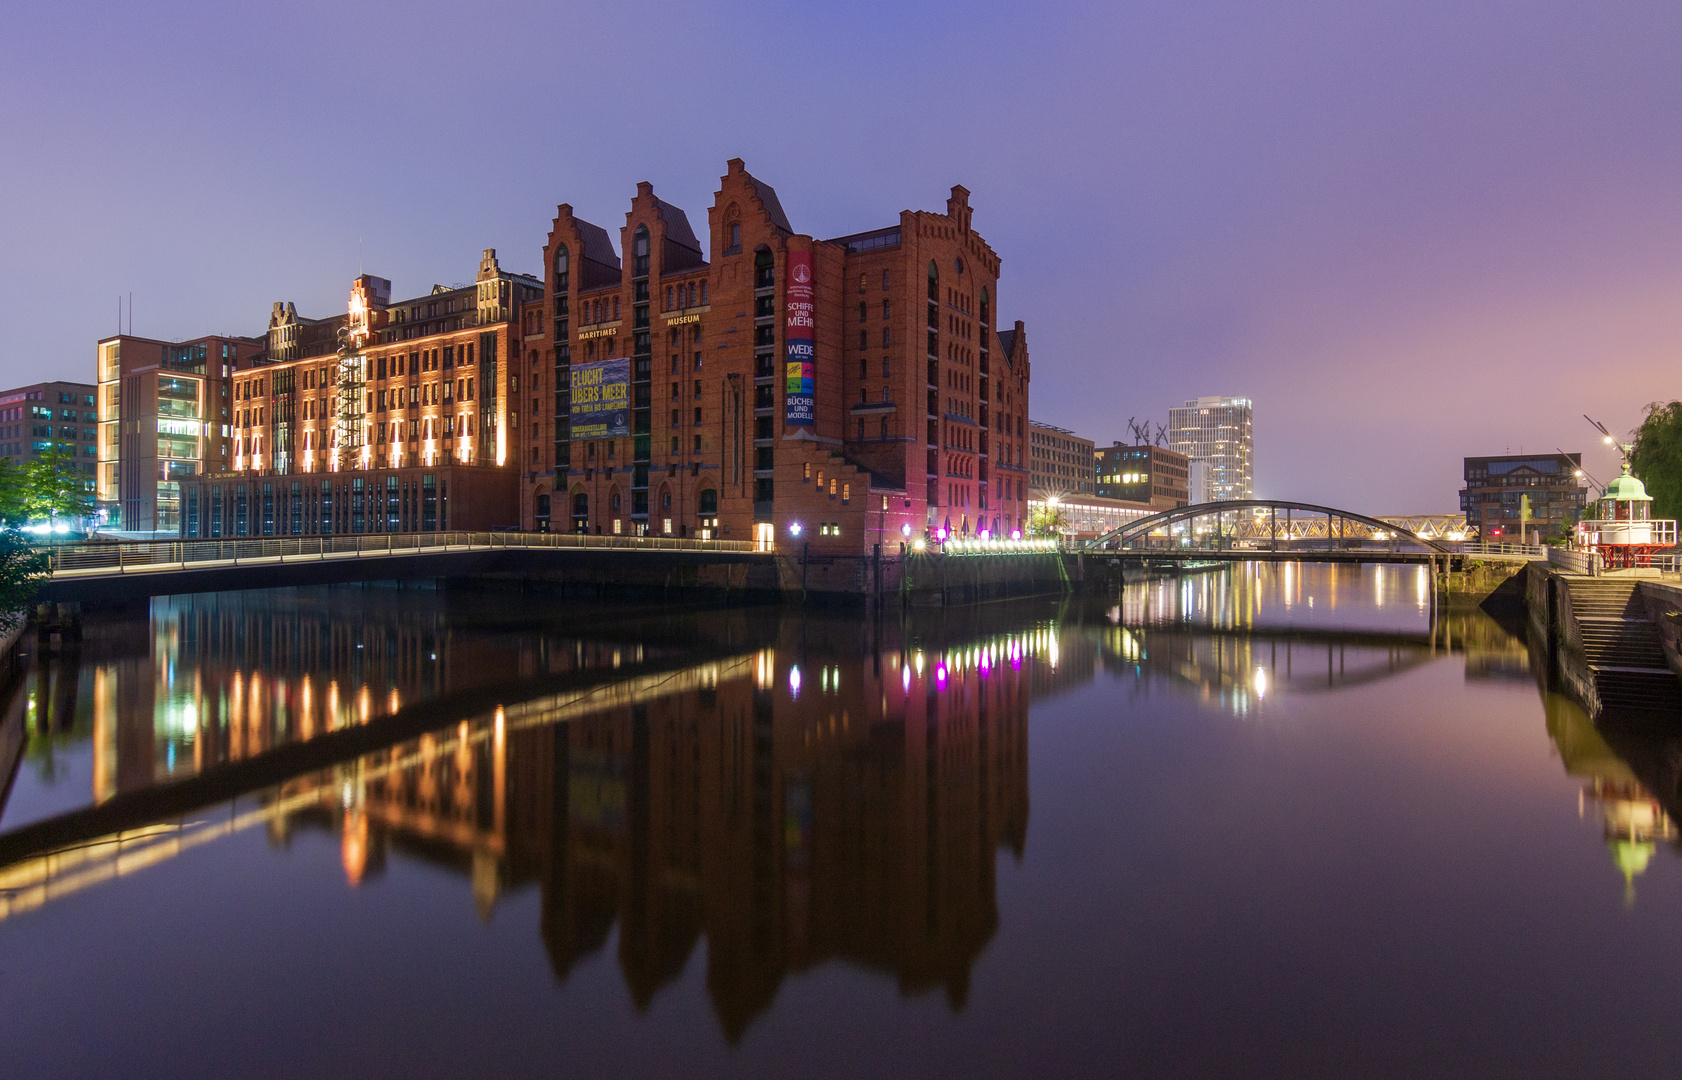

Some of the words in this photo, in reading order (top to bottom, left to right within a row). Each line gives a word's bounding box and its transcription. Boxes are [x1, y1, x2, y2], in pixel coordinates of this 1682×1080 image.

[787, 302, 814, 312] SCHIFFE
[578, 327, 617, 340] MARITIMES
[667, 314, 700, 326] MUSEUM
[787, 316, 814, 328] MEHR
[788, 344, 814, 356] WEDE
[571, 367, 604, 387] FLUCHT
[571, 385, 599, 404] ÜBERS
[602, 382, 627, 401] MEER
[787, 395, 814, 406] BÜCHER
[787, 412, 814, 420] MODELLE
